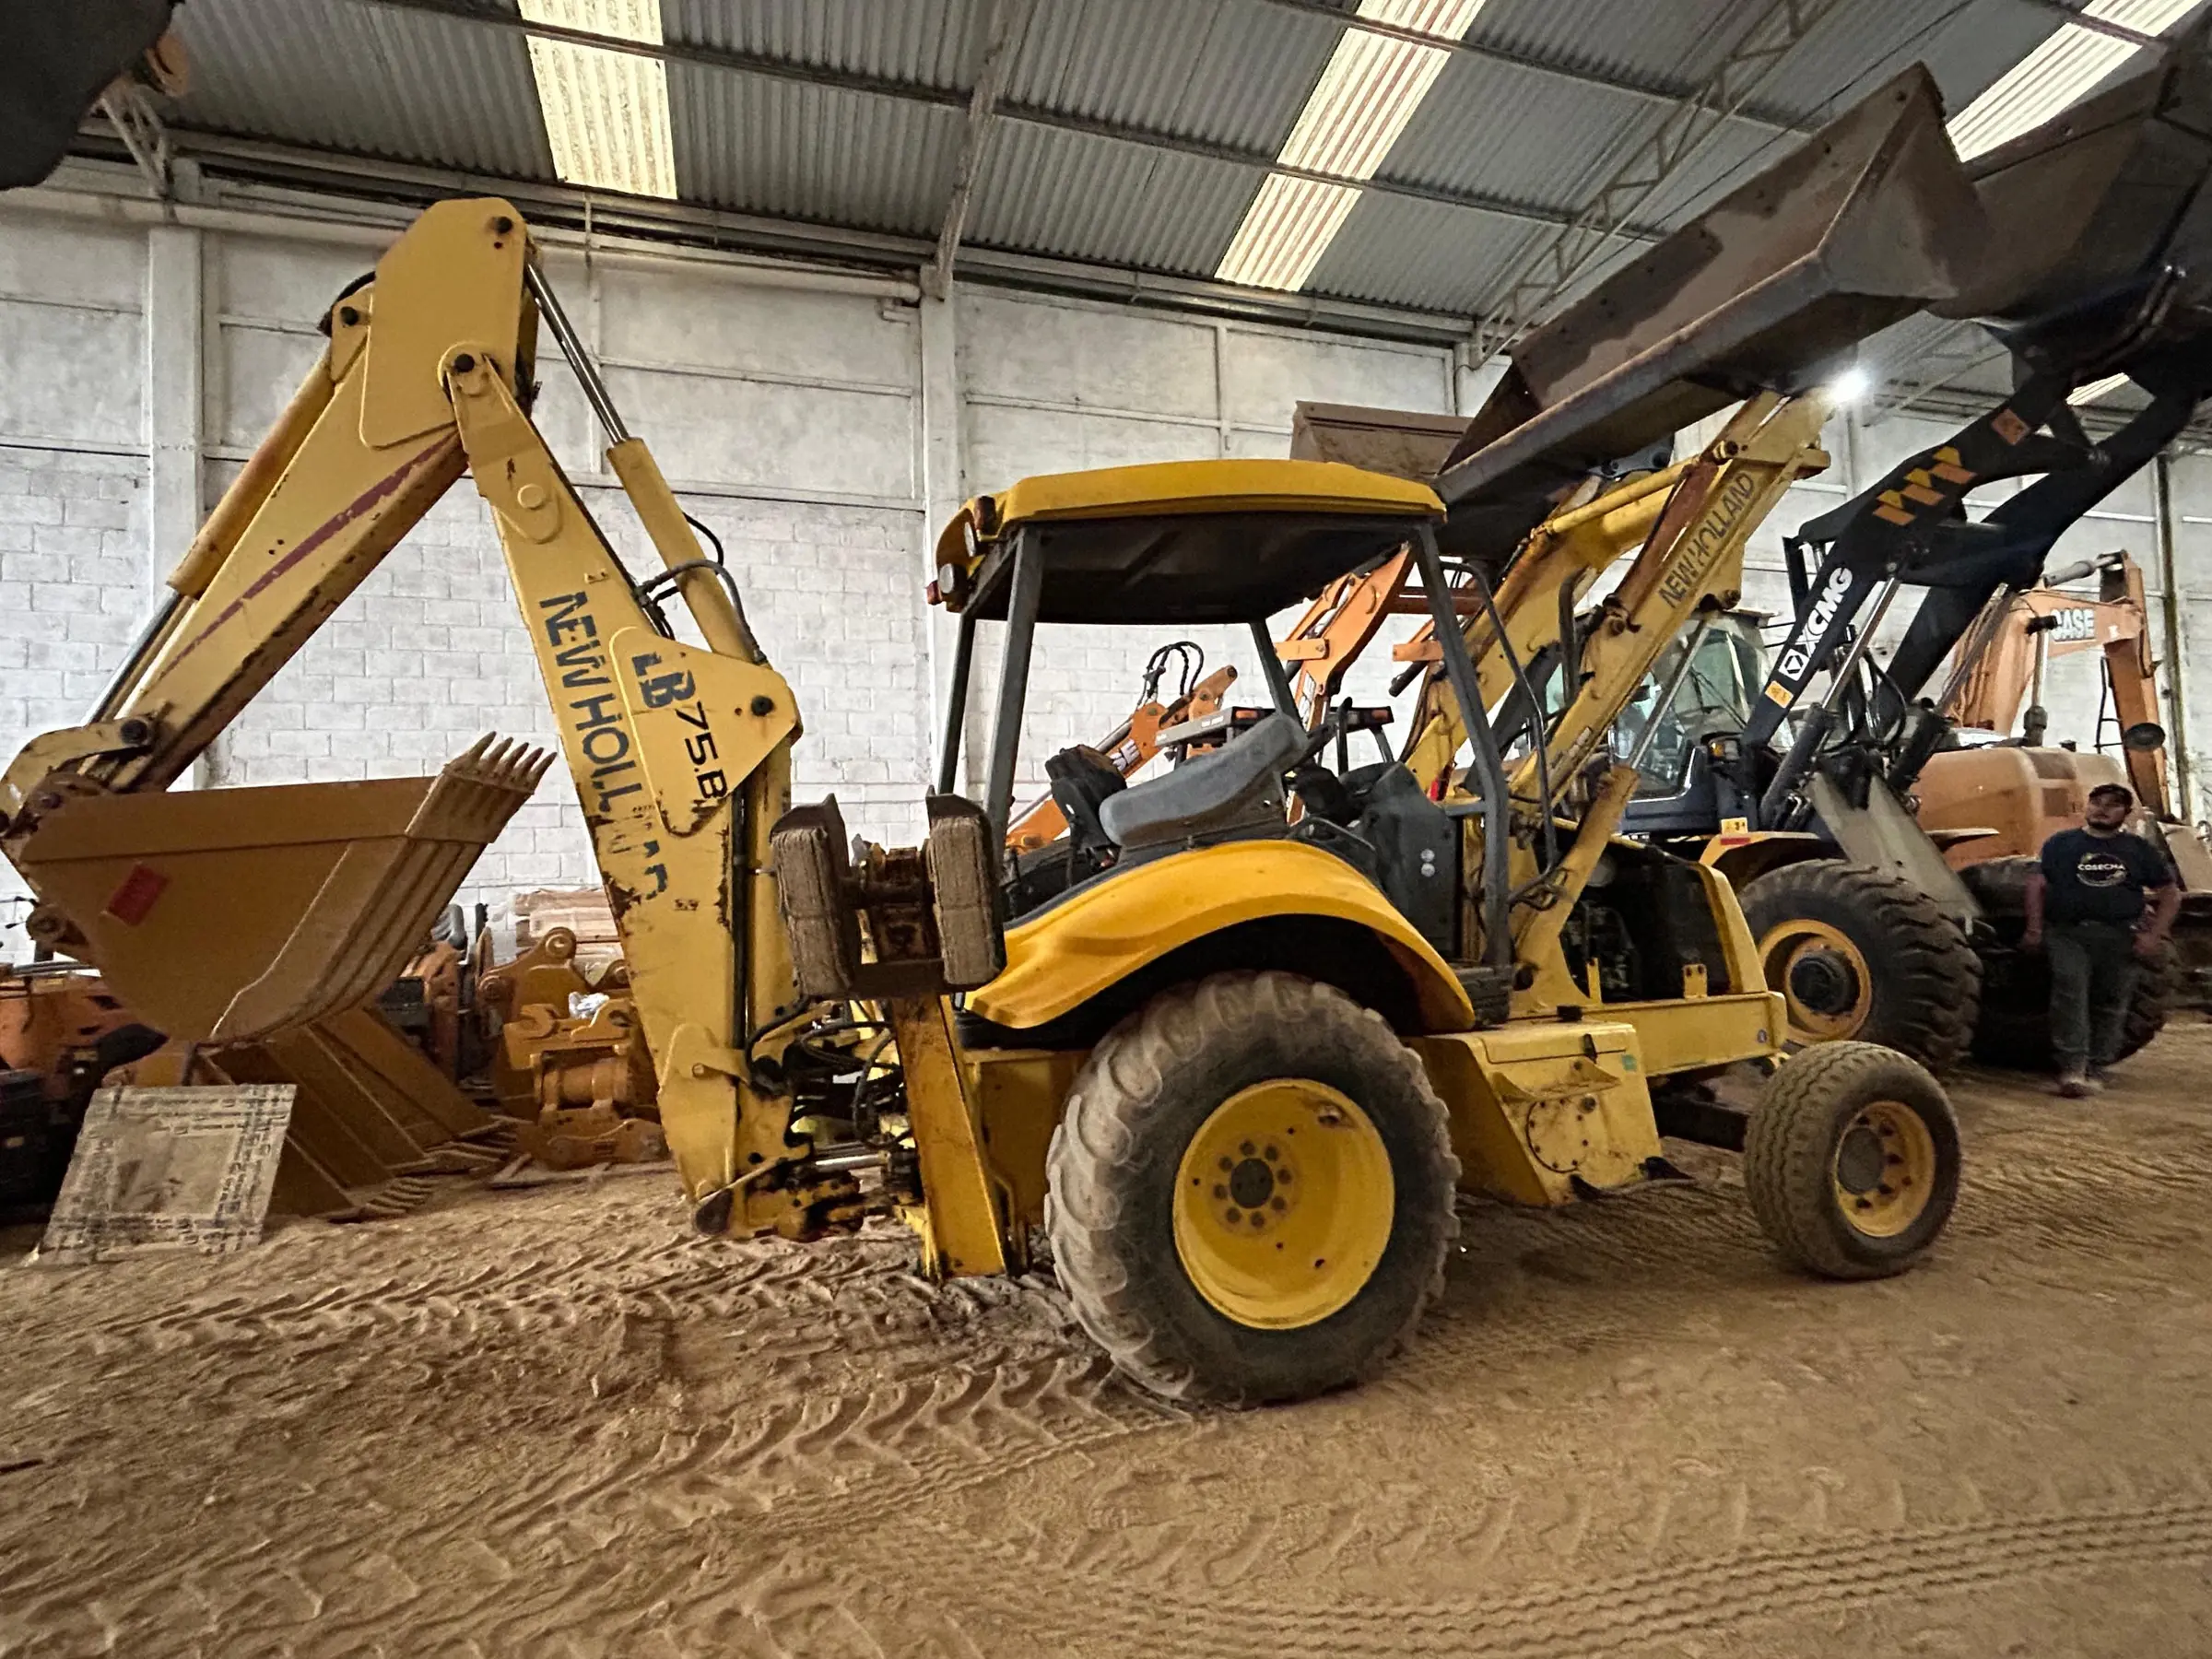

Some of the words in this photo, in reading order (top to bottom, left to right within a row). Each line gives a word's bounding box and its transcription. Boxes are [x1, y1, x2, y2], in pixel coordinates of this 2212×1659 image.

[1659, 554, 1700, 609] NEW
[1688, 472, 1755, 567] HOLLAND
[539, 591, 612, 688] NEW
[1795, 567, 1853, 658] XCMG
